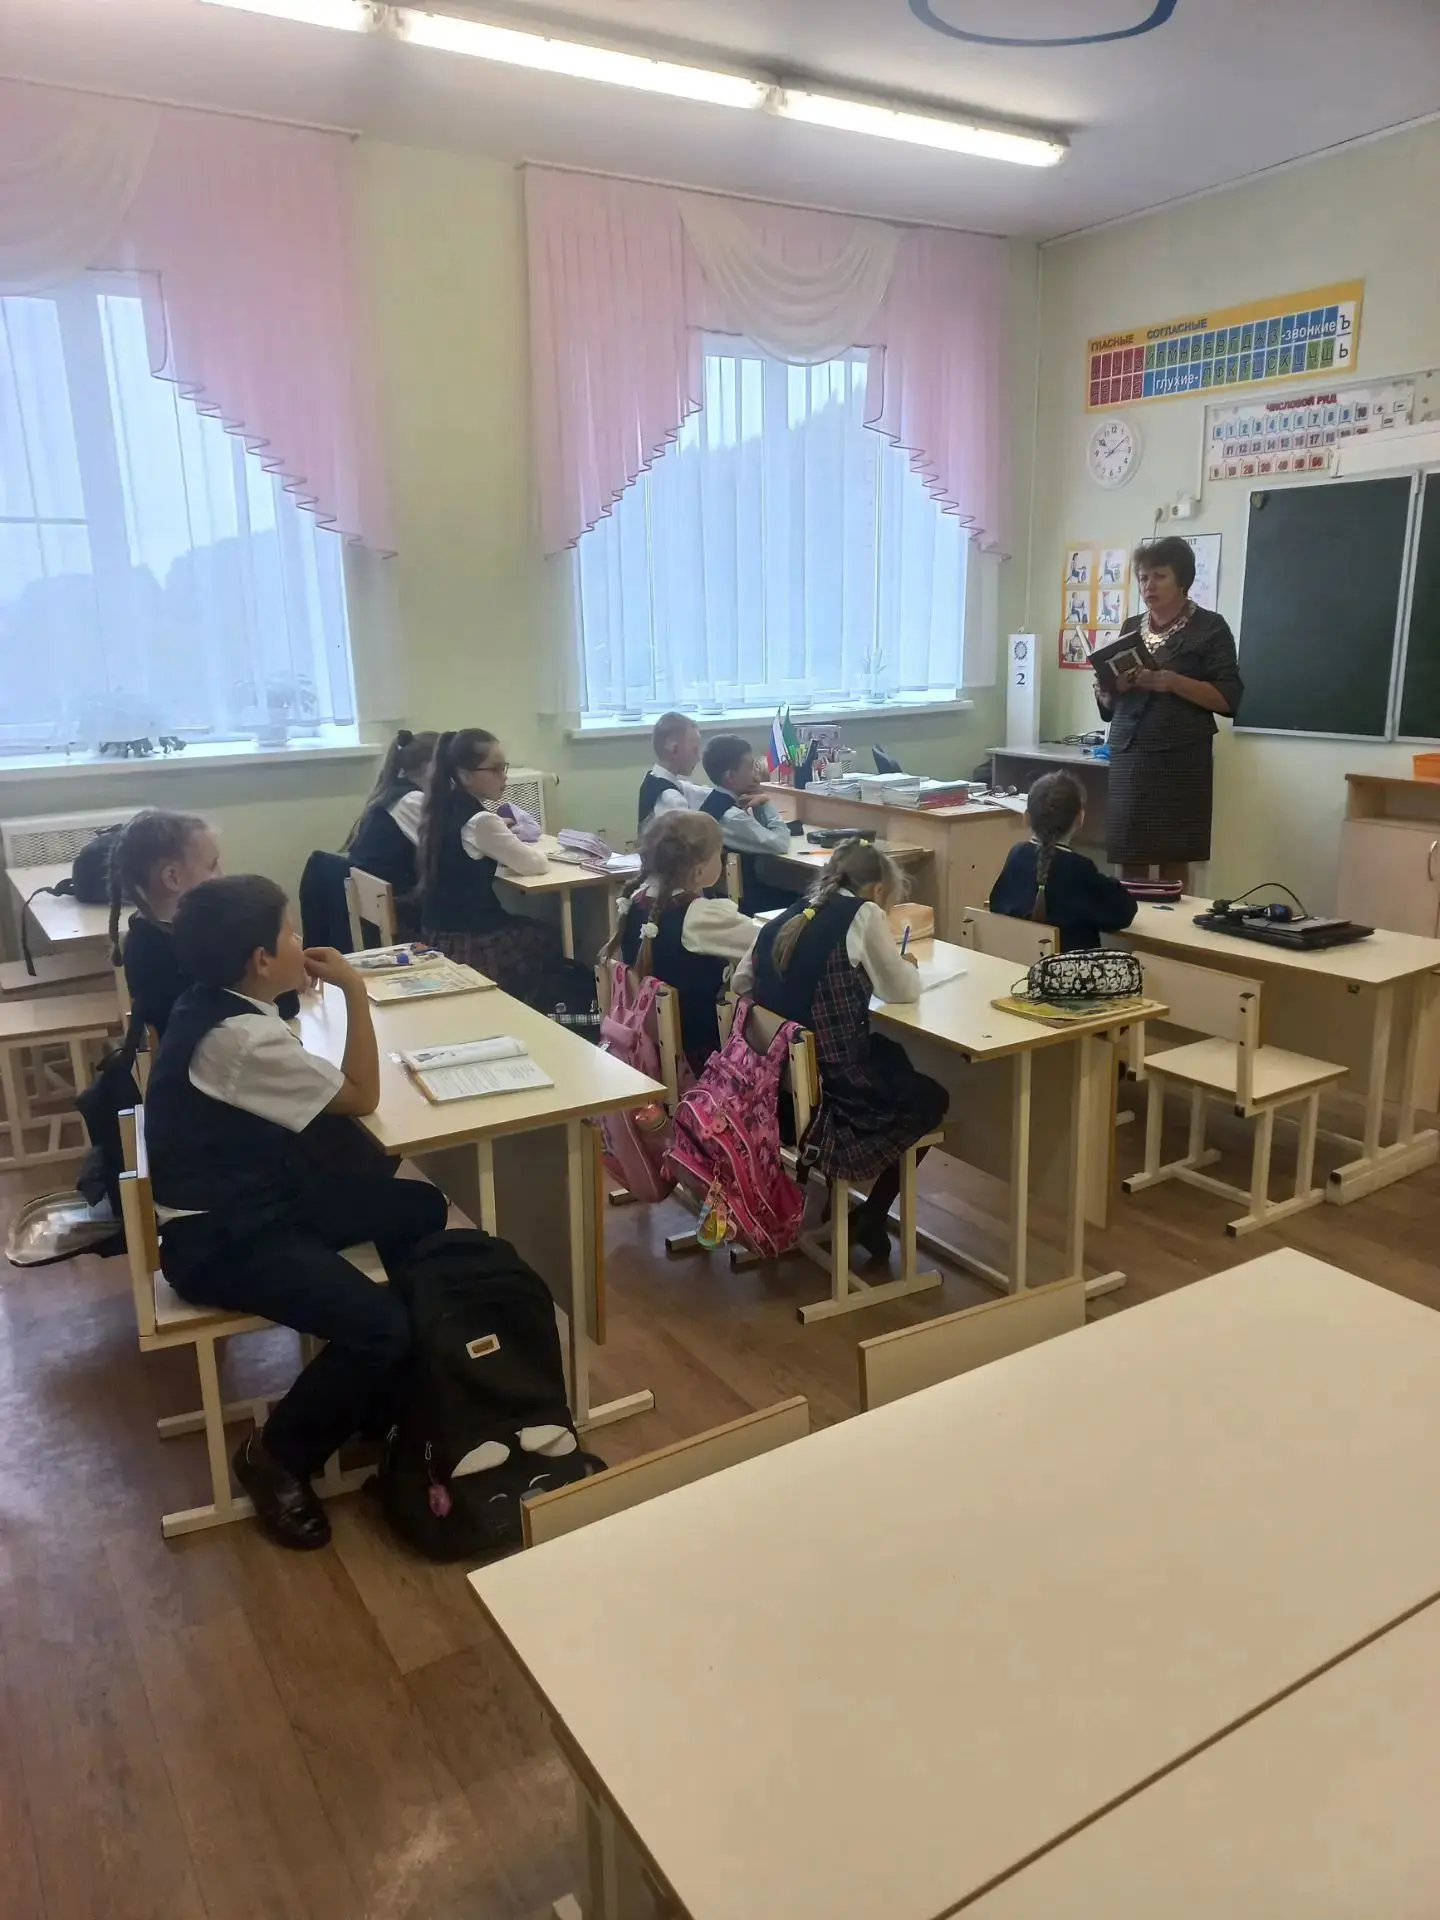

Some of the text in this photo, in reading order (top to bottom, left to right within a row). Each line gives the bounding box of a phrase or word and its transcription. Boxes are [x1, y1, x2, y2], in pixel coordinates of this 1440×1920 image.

[1091, 318, 1208, 351] ГЛАСНЫЕ СОГЛАСНЫЕ
[1204, 341, 1215, 356] Б
[1216, 338, 1225, 354] В
[1339, 315, 1351, 330] Ъ
[1339, 343, 1349, 359] Ь
[1266, 393, 1337, 412] ЧИСЛОВОЙ РЯД
[1357, 406, 1367, 418] 10
[1238, 443, 1248, 454] 12
[1310, 434, 1320, 444] 17
[1243, 464, 1253, 475] 20
[1016, 672, 1026, 685] 2
